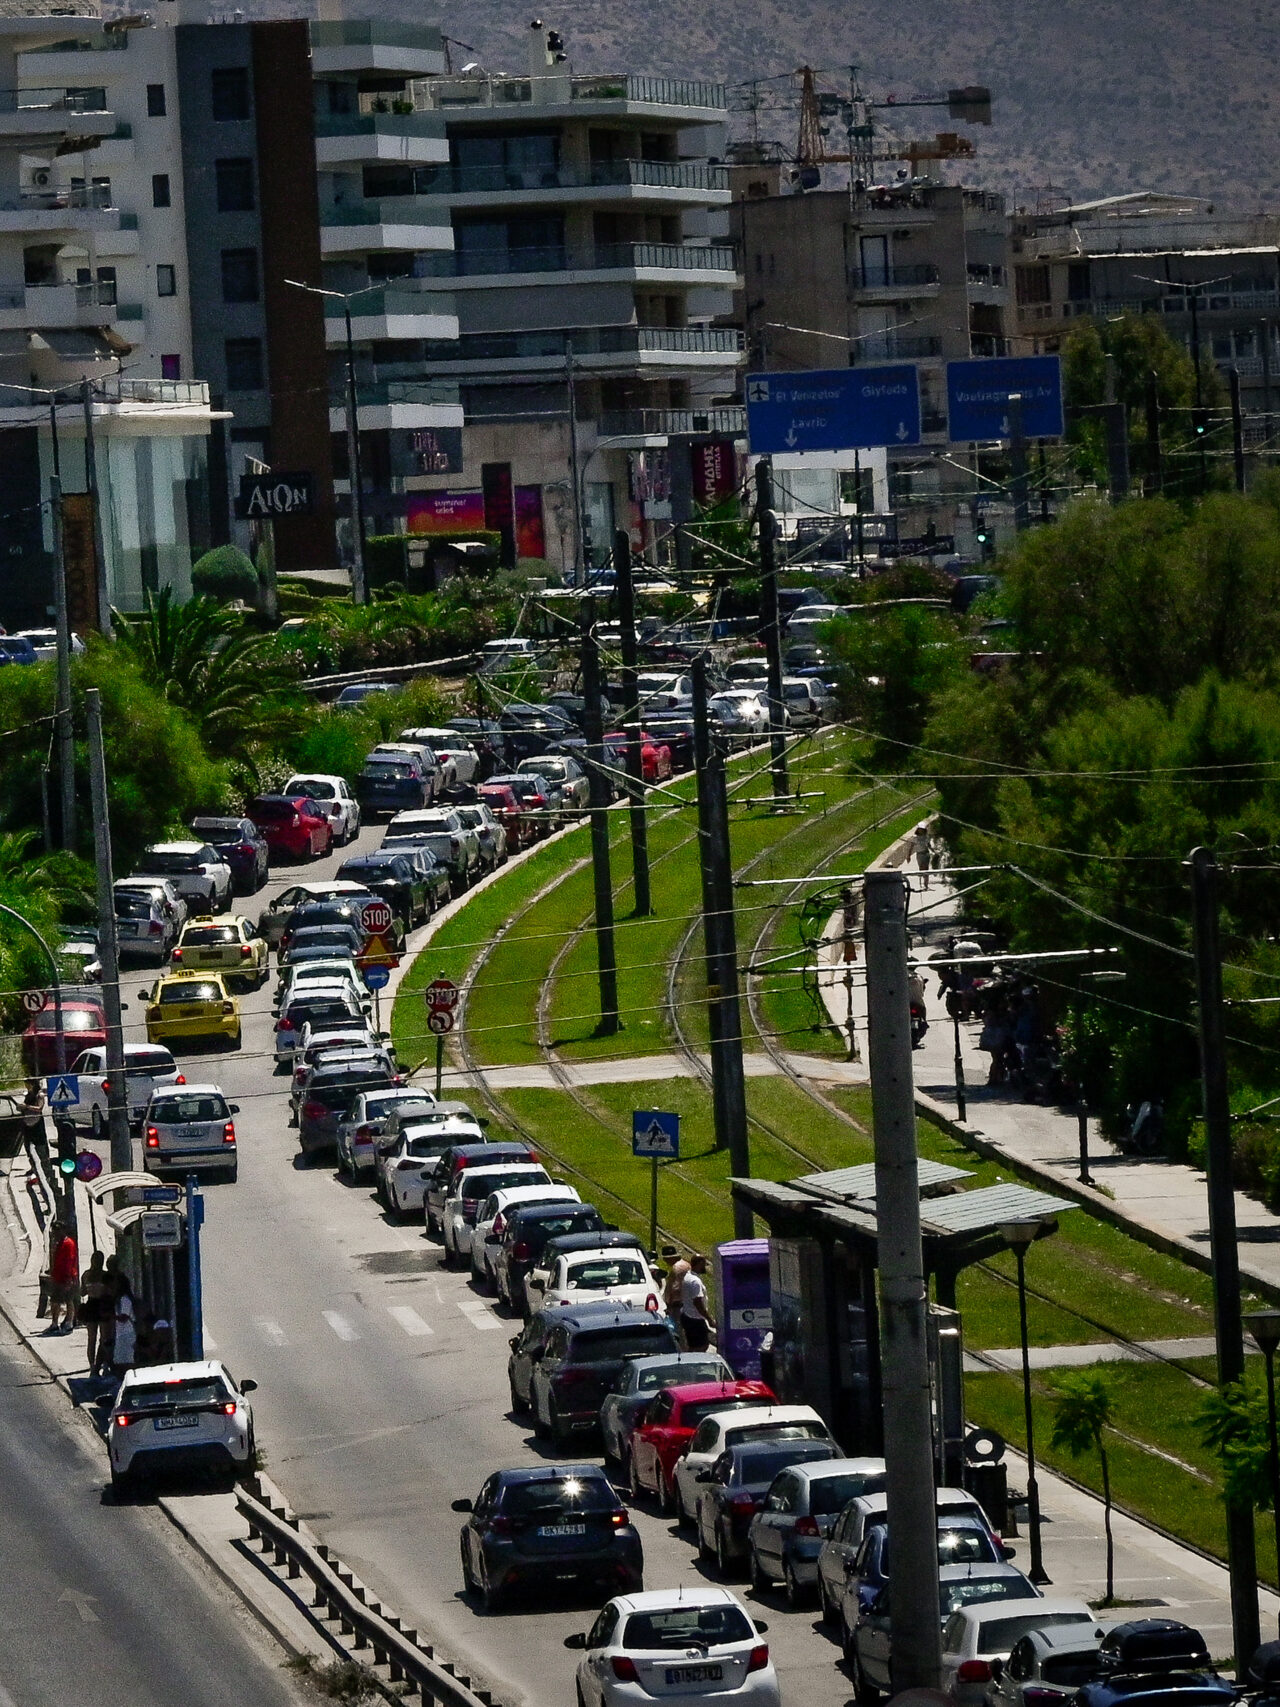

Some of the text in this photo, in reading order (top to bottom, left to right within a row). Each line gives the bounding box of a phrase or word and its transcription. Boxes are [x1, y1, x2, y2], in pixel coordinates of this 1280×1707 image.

[702, 445, 716, 505] ΑΡΙΔΗΣ
[363, 908, 390, 927] STOP
[426, 986, 457, 1005] STOP
